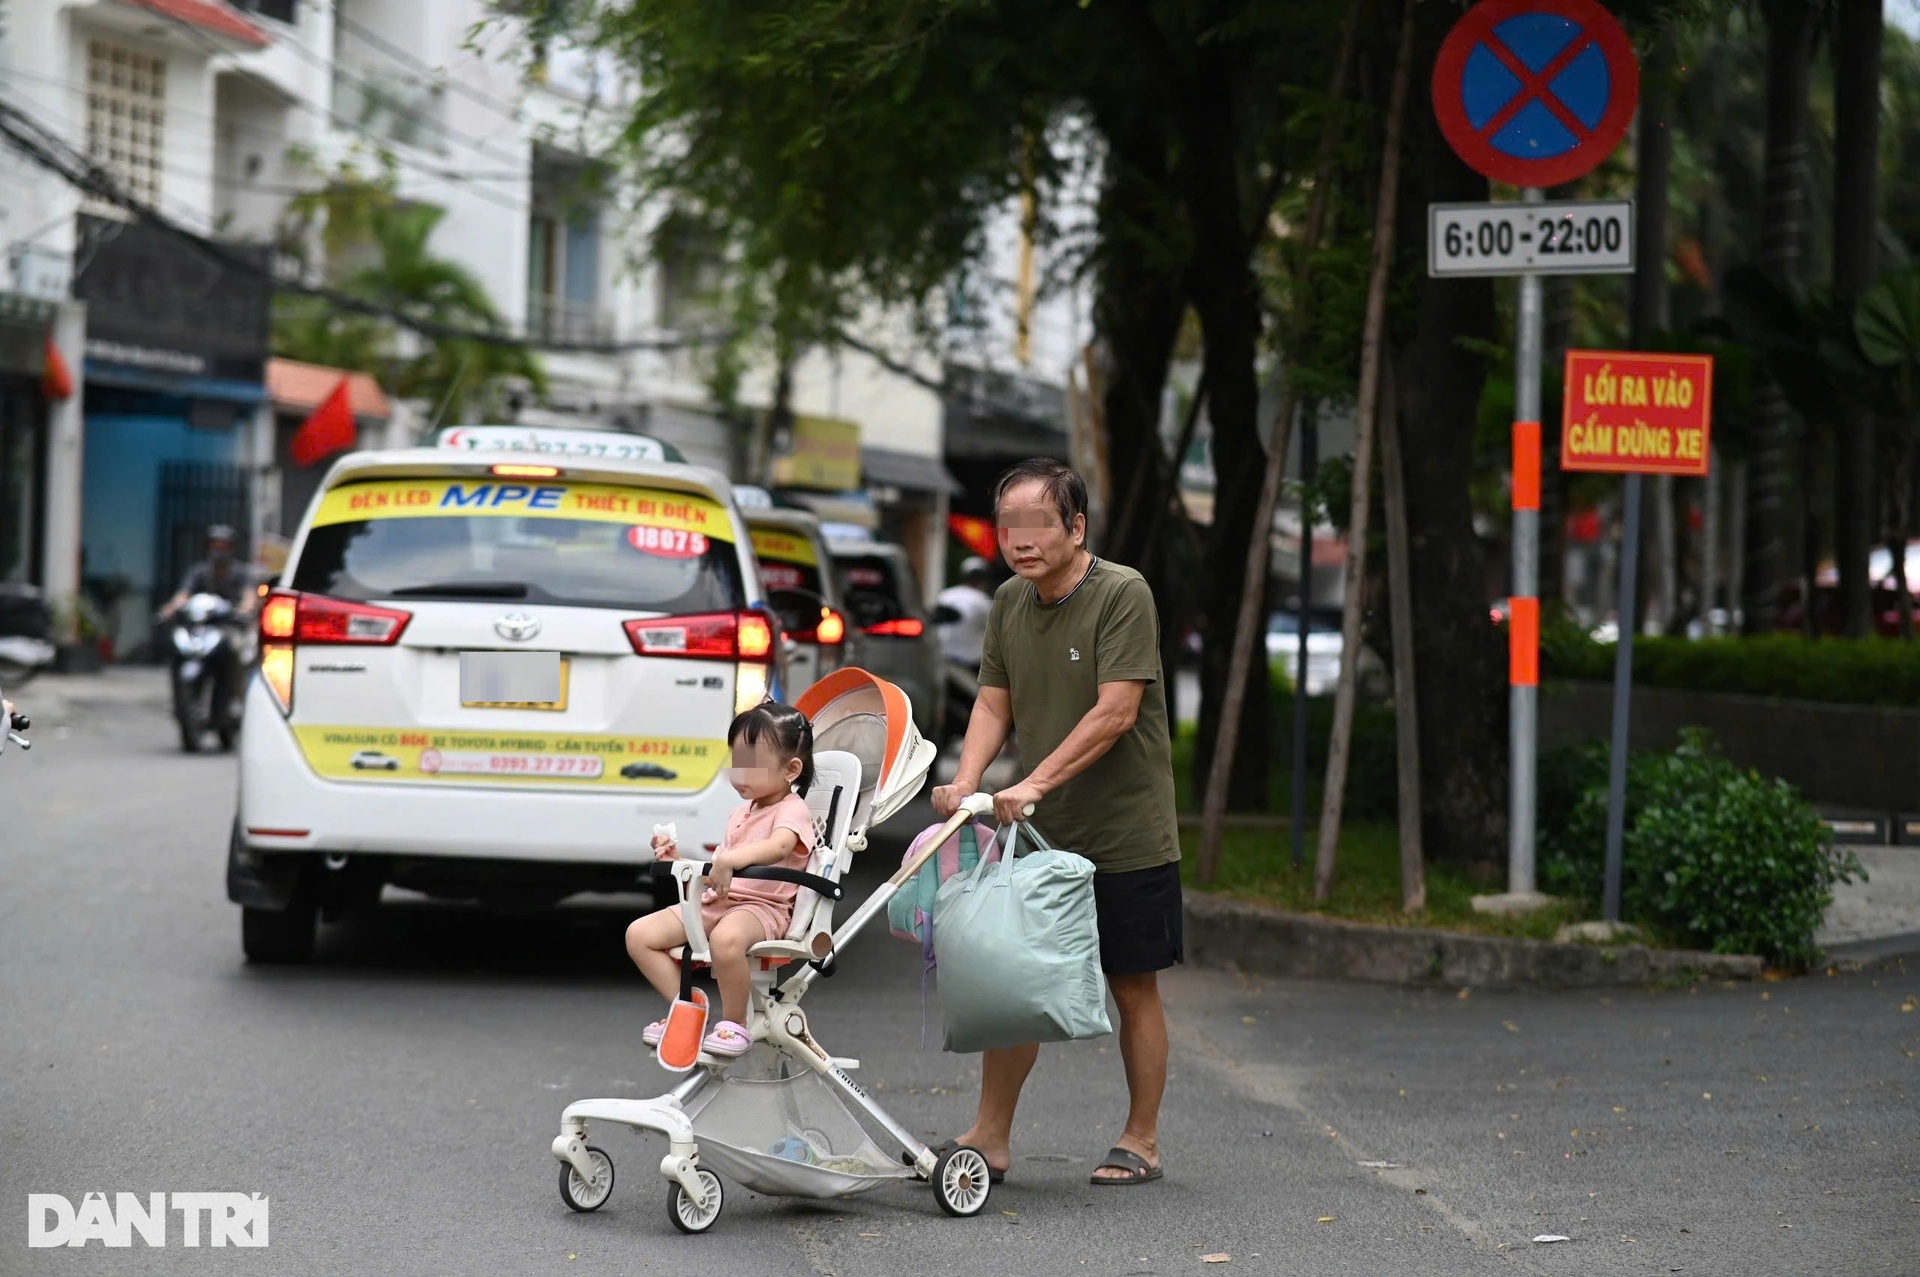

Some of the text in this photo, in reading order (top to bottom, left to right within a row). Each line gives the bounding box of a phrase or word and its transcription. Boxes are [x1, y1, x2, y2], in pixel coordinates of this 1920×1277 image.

[1445, 220, 1513, 257] 6:00
[1538, 217, 1621, 254] 22:00
[1584, 362, 1693, 409] LỐI RA VÀO
[1569, 412, 1703, 459] CẤM DỪNG XE
[394, 489, 432, 507] LED
[440, 485, 568, 509] MPE
[635, 526, 706, 555] 18075
[324, 733, 378, 745] VINASUN
[450, 736, 496, 748] TOYOTA
[500, 738, 546, 750] HYBRID
[628, 741, 671, 756] 1.612
[694, 745, 709, 756] XE
[557, 758, 577, 773] 27
[580, 759, 600, 773] 27
